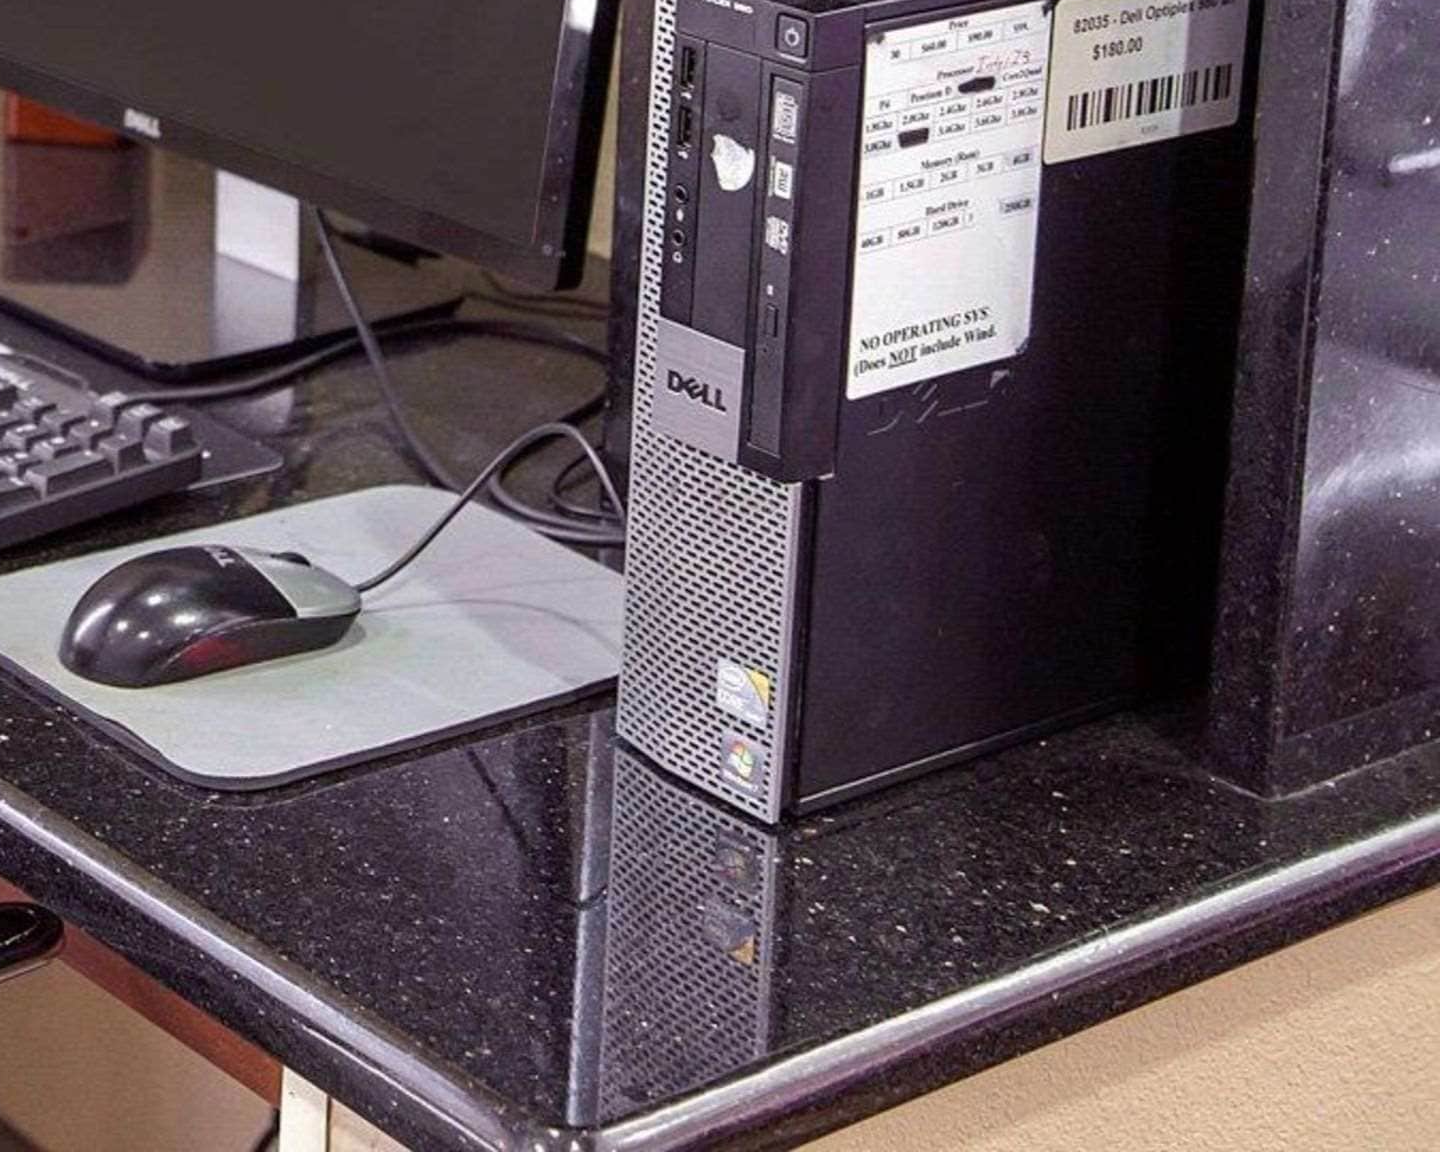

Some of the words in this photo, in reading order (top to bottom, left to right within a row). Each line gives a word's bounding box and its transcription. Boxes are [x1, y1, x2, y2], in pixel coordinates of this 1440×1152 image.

[1120, 9, 1143, 25] Dell
[860, 335, 880, 353] NO
[881, 312, 961, 347] OPERATING
[853, 359, 886, 378] (Does
[887, 345, 918, 368] NOT
[920, 335, 962, 357] include
[667, 369, 728, 413] DELL
